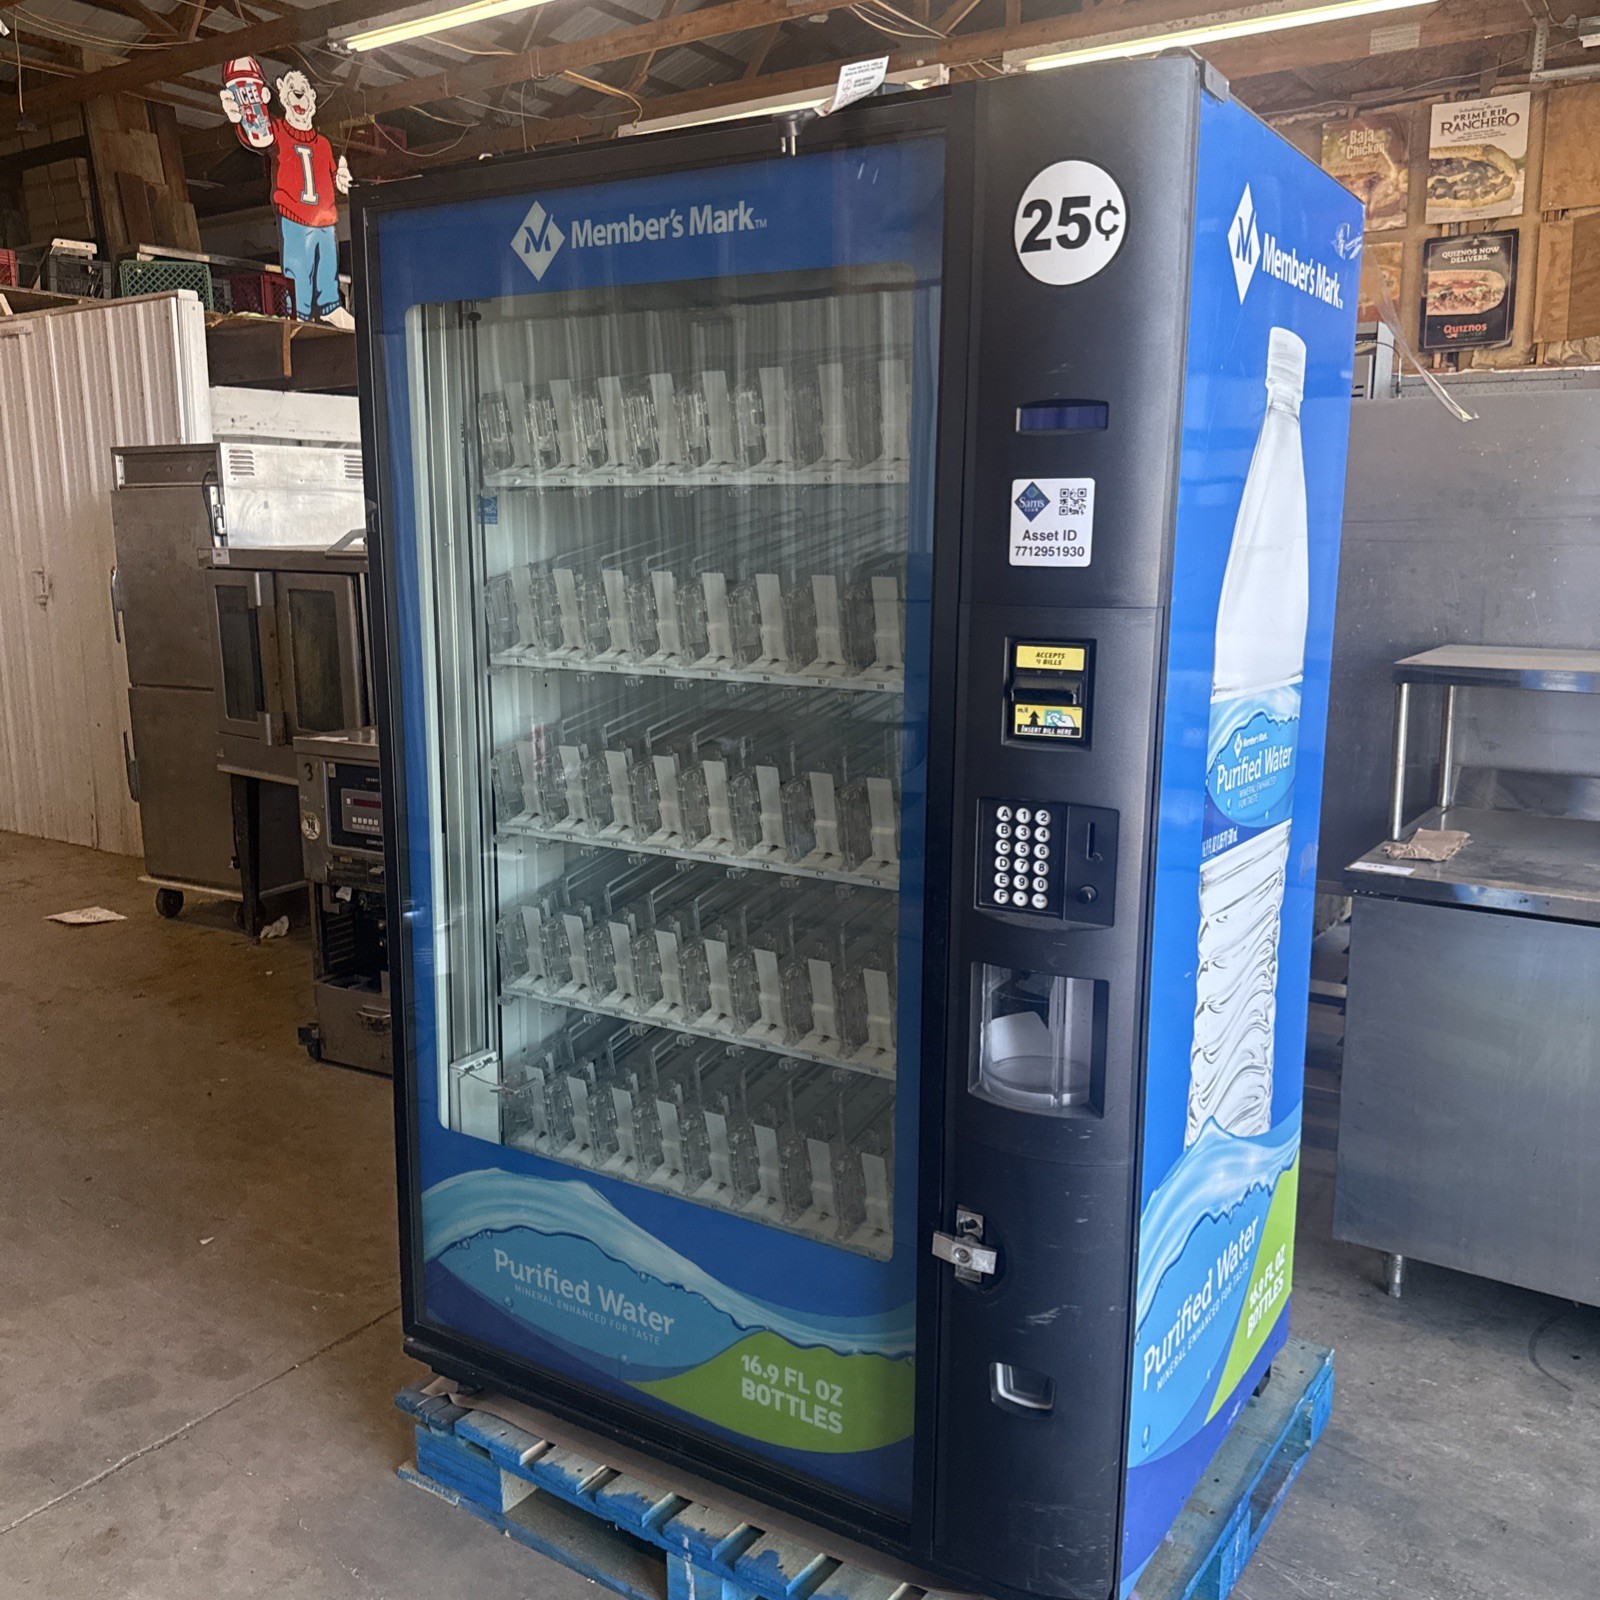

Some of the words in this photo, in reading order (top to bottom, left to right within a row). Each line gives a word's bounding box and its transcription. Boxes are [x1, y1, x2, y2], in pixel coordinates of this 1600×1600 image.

[235, 85, 262, 106] ICEE
[1453, 110, 1487, 121] PRIME
[1490, 108, 1507, 117] RIB
[1440, 112, 1520, 136] RANCHERO
[1349, 127, 1375, 146] Baja
[1346, 143, 1385, 160] Chicken
[571, 208, 684, 249] Member's
[689, 200, 755, 236] Mark
[1020, 195, 1120, 253] 25¢
[1442, 247, 1478, 259] QUIZNOS
[1479, 246, 1500, 255] NOW
[1450, 254, 1490, 264] DELIVERS.
[1262, 232, 1316, 295] Member's
[1315, 262, 1341, 309] Mark
[1443, 323, 1488, 334] Quiznos
[1022, 529, 1059, 541] Asset
[1063, 530, 1077, 541] ID
[1014, 546, 1085, 557] 7712951930
[1020, 725, 1042, 733] INSERT
[1043, 726, 1055, 734] BILL
[1057, 728, 1072, 736] HERE
[304, 763, 313, 781] 3
[1217, 750, 1262, 795] Purified
[1264, 745, 1293, 775] Water
[1001, 809, 1009, 817] A
[1022, 811, 1027, 819] 1
[1041, 813, 1046, 821] 2
[1001, 825, 1008, 834] B
[1021, 828, 1026, 836] 3
[1040, 830, 1046, 838] 4
[1000, 842, 1008, 851] C
[1020, 844, 1026, 853] 5
[1039, 846, 1045, 855] 6
[1000, 859, 1007, 867] D
[1019, 861, 1025, 869] 7
[1039, 863, 1044, 872] 8
[1000, 875, 1006, 884] E
[1019, 877, 1025, 886] 9
[1038, 880, 1044, 888] 0
[999, 892, 1005, 900] F
[1264, 1261, 1275, 1288] FL
[1275, 1243, 1286, 1271] OZ
[493, 1248, 592, 1306] Purified
[597, 1284, 675, 1335] Water
[1143, 1267, 1213, 1391] Purified
[1216, 1215, 1259, 1290] Water
[1246, 1270, 1285, 1339] BOTTLES
[514, 1284, 554, 1306] MINERAL
[556, 1299, 607, 1326] ENHANCED
[609, 1320, 628, 1333] FOR
[630, 1327, 661, 1346] TASTE
[1156, 1349, 1186, 1392] MINERAL
[1187, 1299, 1220, 1350] ENHANCED
[1220, 1282, 1233, 1300] FOR
[1233, 1258, 1249, 1287] TASTE
[741, 1354, 779, 1386] 16.9
[784, 1366, 811, 1395] FL
[815, 1379, 843, 1408] OZ
[741, 1376, 843, 1435] BOTTLES
